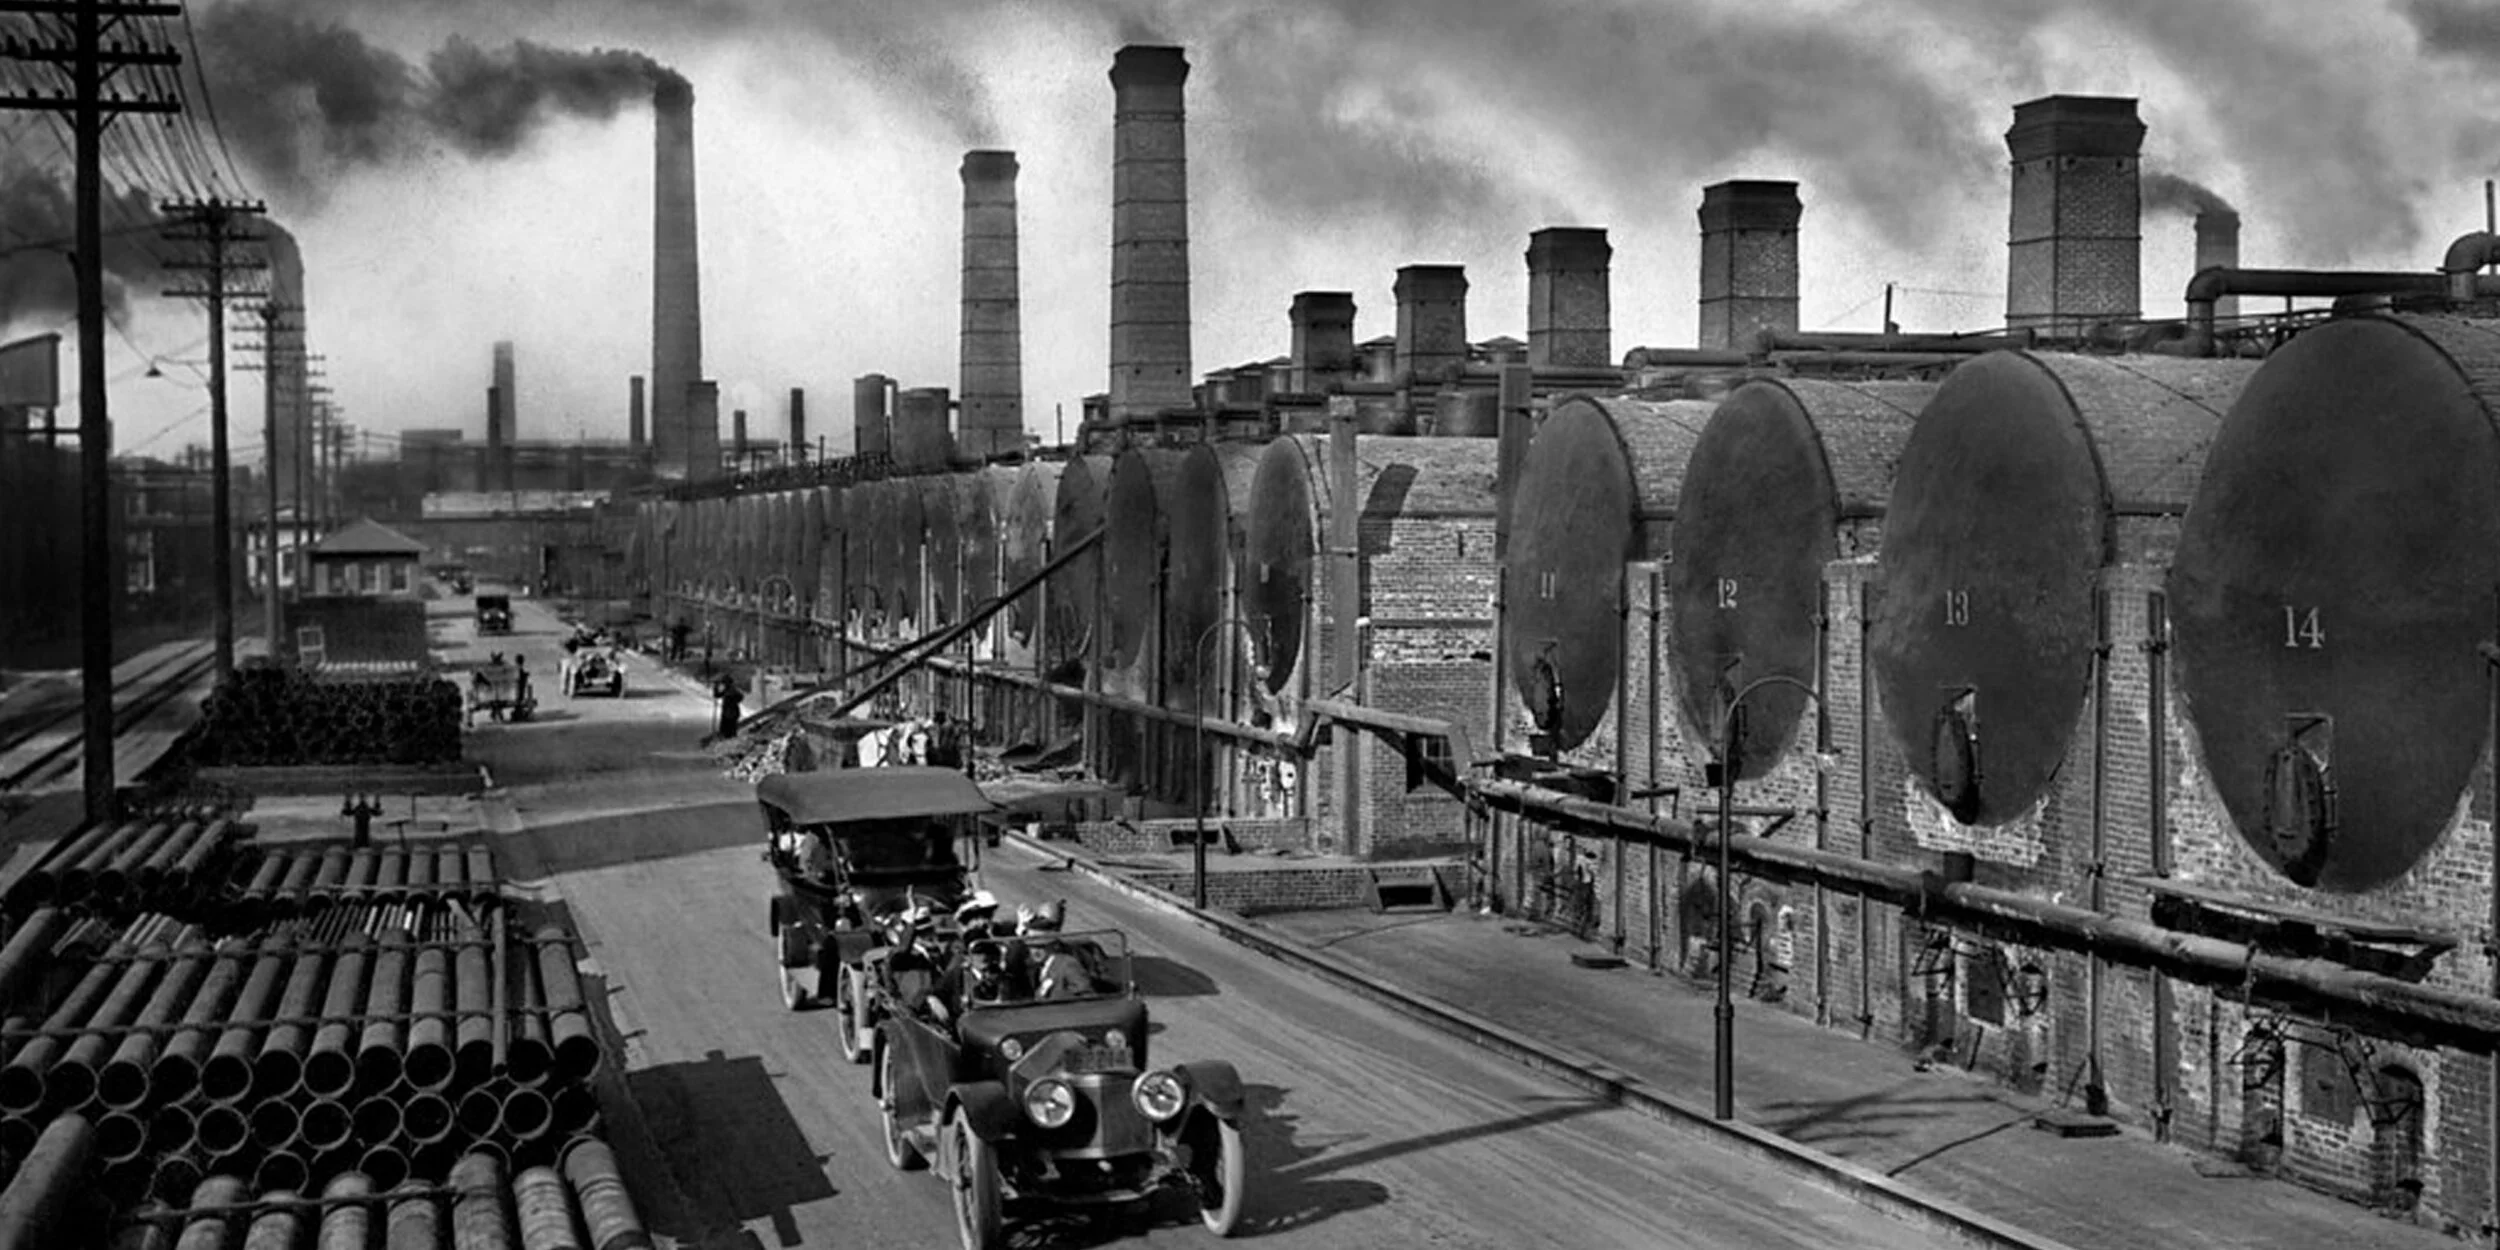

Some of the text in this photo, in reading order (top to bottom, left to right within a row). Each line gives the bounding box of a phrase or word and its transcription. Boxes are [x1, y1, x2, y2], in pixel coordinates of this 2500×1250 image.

[1541, 571, 1556, 600] 11
[1718, 576, 1738, 610] 12
[1944, 589, 1969, 627] 13
[2284, 605, 2326, 648] 14
